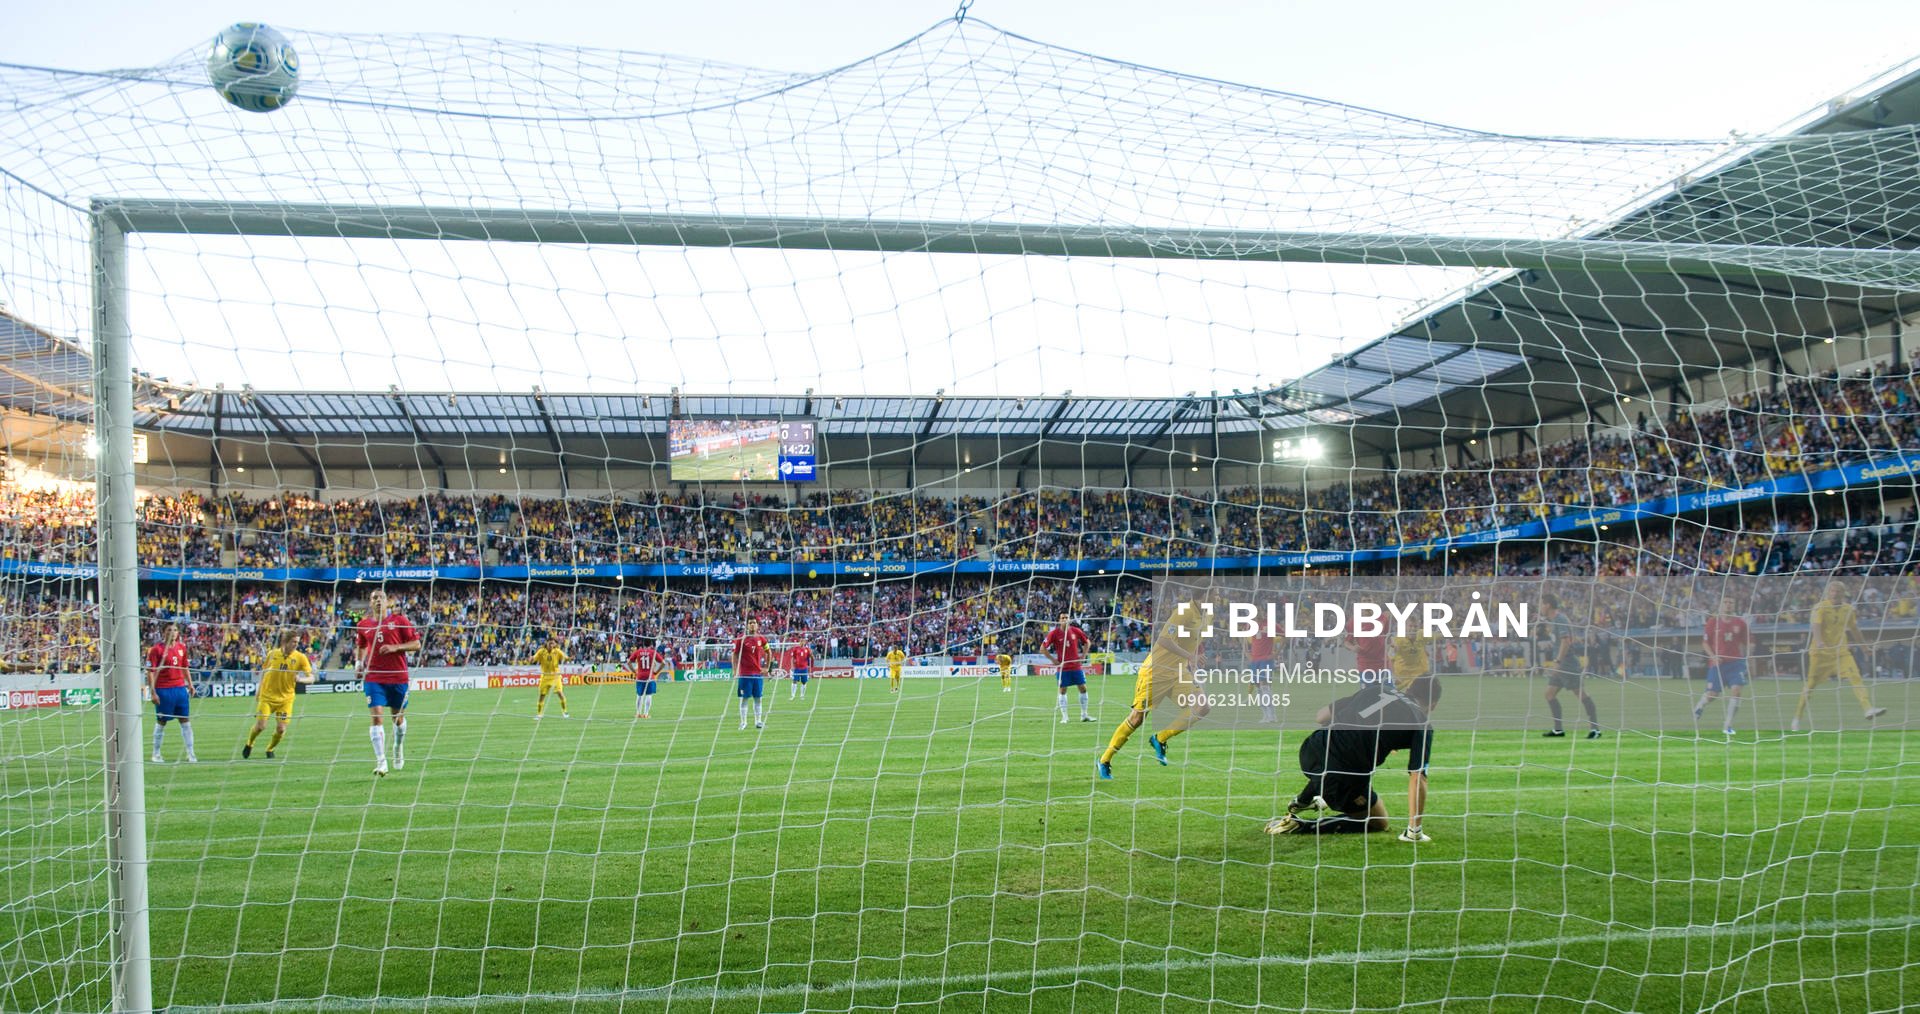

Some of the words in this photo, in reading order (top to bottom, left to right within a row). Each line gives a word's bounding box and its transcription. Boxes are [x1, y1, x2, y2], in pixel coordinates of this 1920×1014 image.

[781, 430, 789, 440] 0
[803, 430, 809, 440] 1
[782, 444, 811, 454] 14:22
[1861, 464, 1909, 479] Sweden
[1700, 494, 1722, 506] UEFA
[1287, 556, 1308, 564] UEFA
[1309, 554, 1344, 563] UNDER21
[30, 565, 53, 574] UEFA
[530, 568, 569, 576] Sweden
[571, 568, 596, 576] 2009
[844, 565, 881, 573] Sweden
[882, 564, 906, 572] 2009
[998, 563, 1020, 571] UEFA
[192, 571, 235, 580] Sweden
[237, 570, 264, 579] 2009
[369, 570, 394, 578] UEFA
[395, 569, 439, 578] UNDER21
[376, 631, 384, 643] 5
[172, 656, 179, 665] 3
[640, 656, 651, 670] 11
[683, 669, 731, 681] Carlsberg
[212, 683, 258, 697] RESP
[334, 681, 364, 692] adid
[416, 680, 438, 691] TUI
[440, 679, 477, 690] Travel
[1358, 692, 1400, 719] 1
